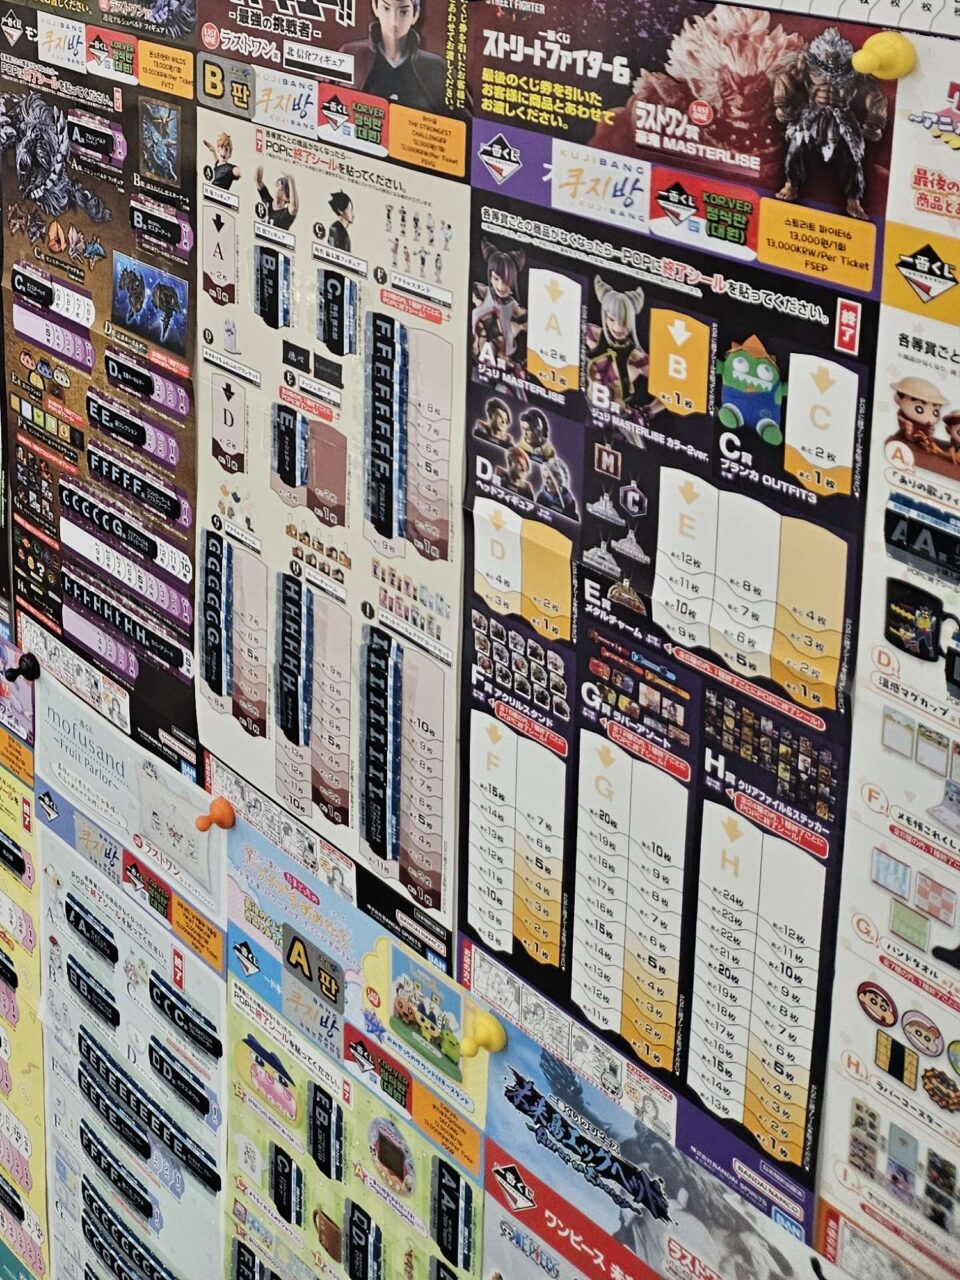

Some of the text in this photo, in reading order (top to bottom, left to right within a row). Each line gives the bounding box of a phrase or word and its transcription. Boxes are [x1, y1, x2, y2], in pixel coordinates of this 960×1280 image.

[515, 0, 545, 14] FIGHTER
[483, 29, 631, 85] ストリートファイター6
[204, 66, 249, 109] B 판
[482, 68, 603, 107] 最後のくじ券を引いた
[481, 83, 616, 126] お客様に商品とあわせて
[481, 99, 569, 130] お渡しください。
[664, 138, 760, 170] MASTERLISE
[784, 217, 816, 233] 스트리트
[804, 260, 828, 273] FSEP
[841, 256, 870, 271] Ticket
[544, 312, 563, 337] A
[668, 354, 688, 380] B
[611, 415, 665, 445] MASTERLISE
[808, 404, 832, 432] C
[762, 475, 818, 505] OUTFIT3
[46, 704, 126, 778] mofusand
[289, 935, 339, 1003] A 판
